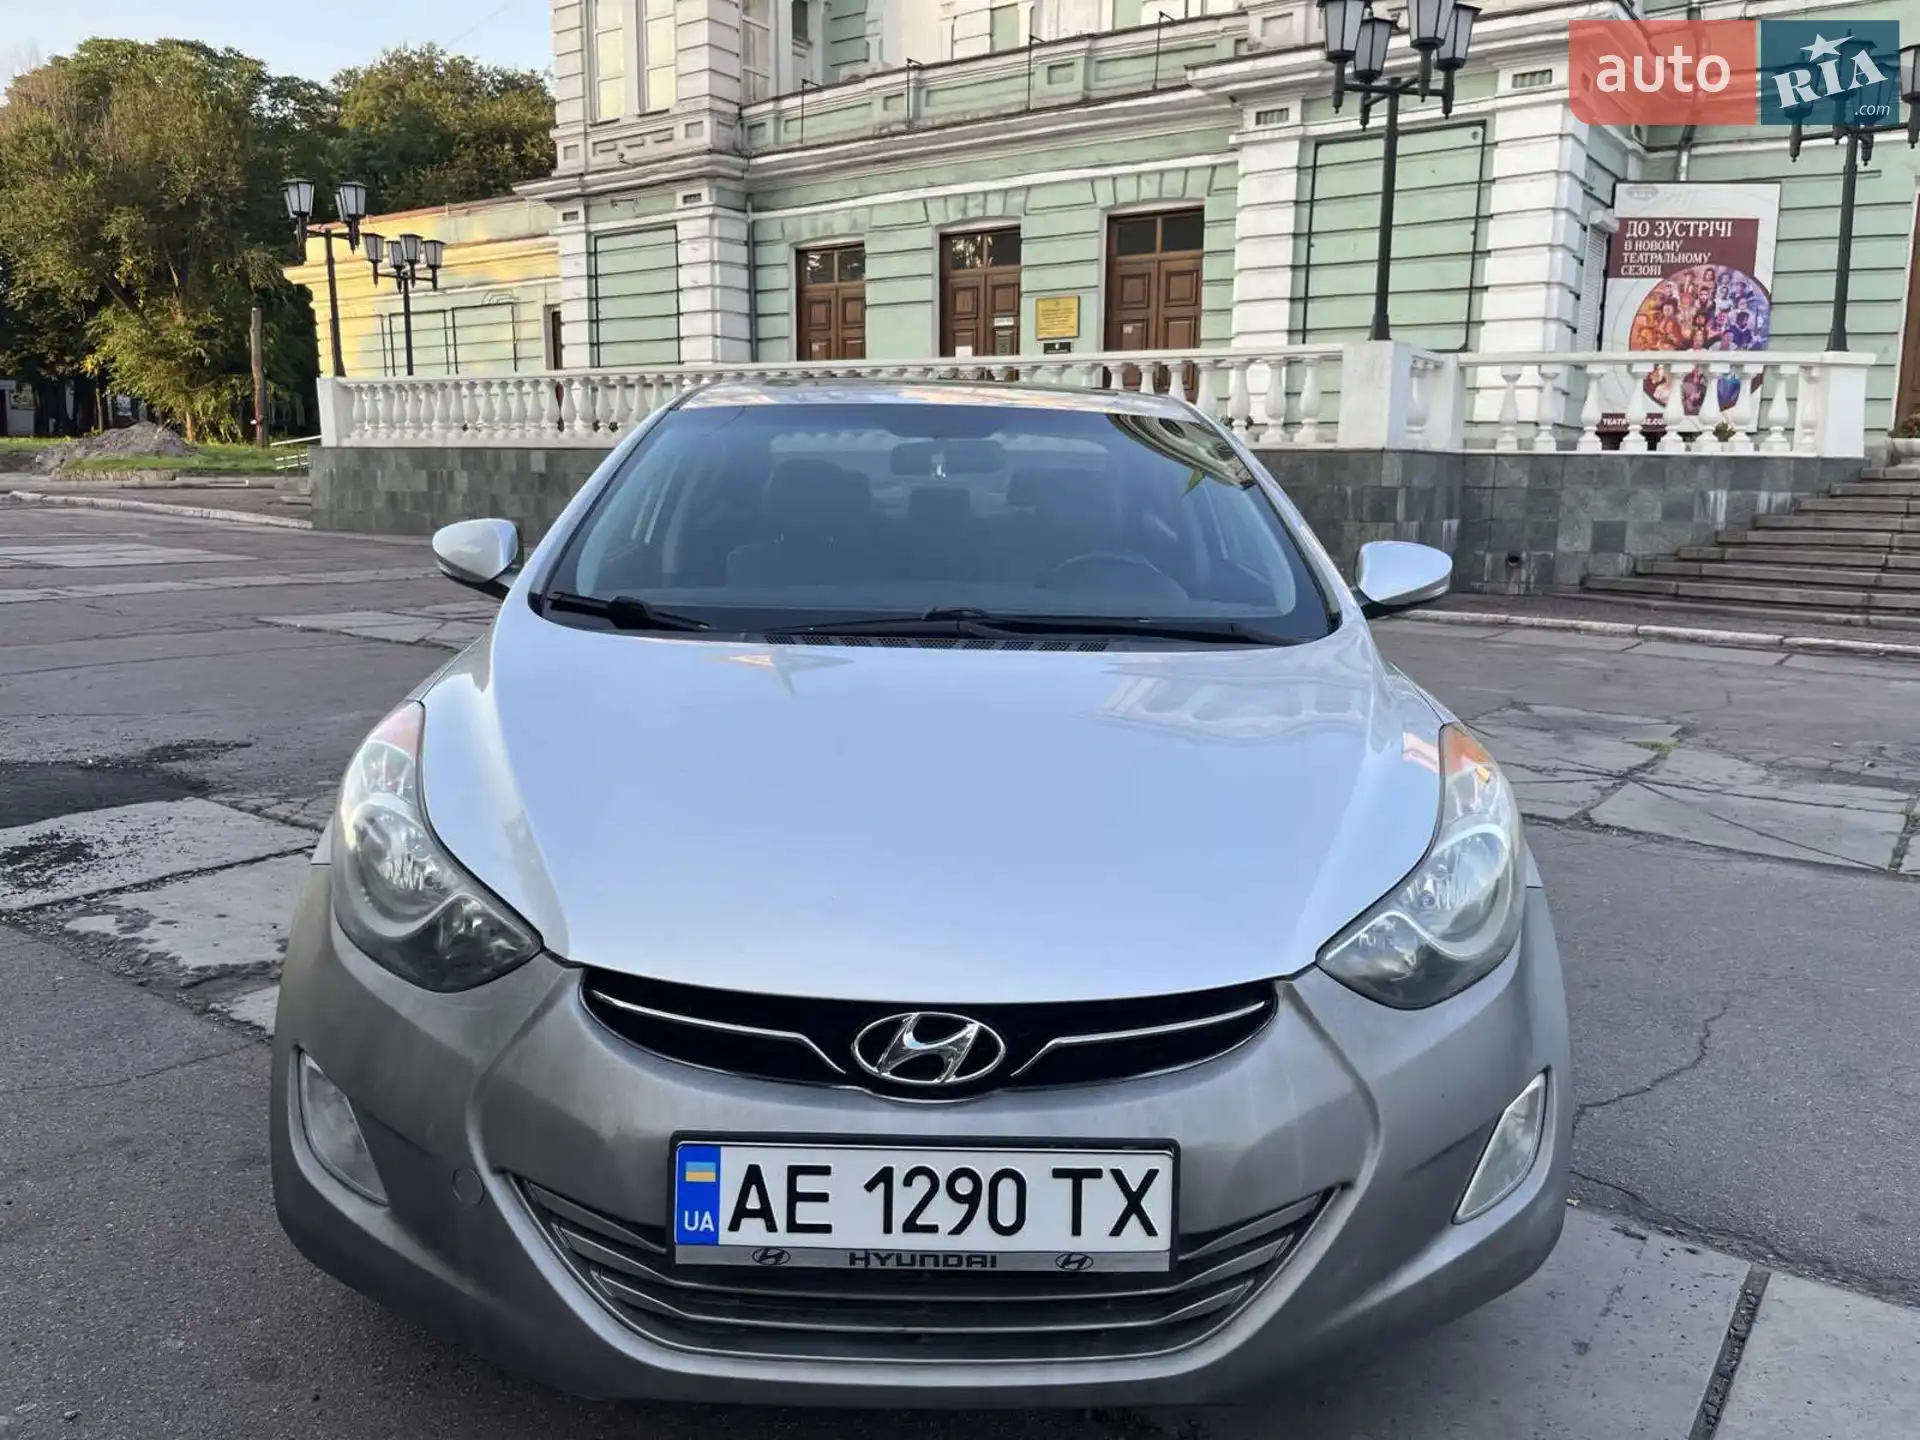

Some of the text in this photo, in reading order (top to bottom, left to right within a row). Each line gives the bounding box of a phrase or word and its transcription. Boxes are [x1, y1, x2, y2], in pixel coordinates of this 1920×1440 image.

[1625, 220, 1733, 238] ДО ЗУСТРІЧІ
[1624, 240, 1683, 252] В НОВОМУ
[1622, 252, 1712, 265] ТЕАТРАЛЬНОМУ
[1620, 265, 1662, 276] СЕЗОНІ
[728, 1164, 1160, 1237] AE 1290 TX
[684, 1210, 714, 1233] UA
[849, 1251, 997, 1269] HYUNDAI
